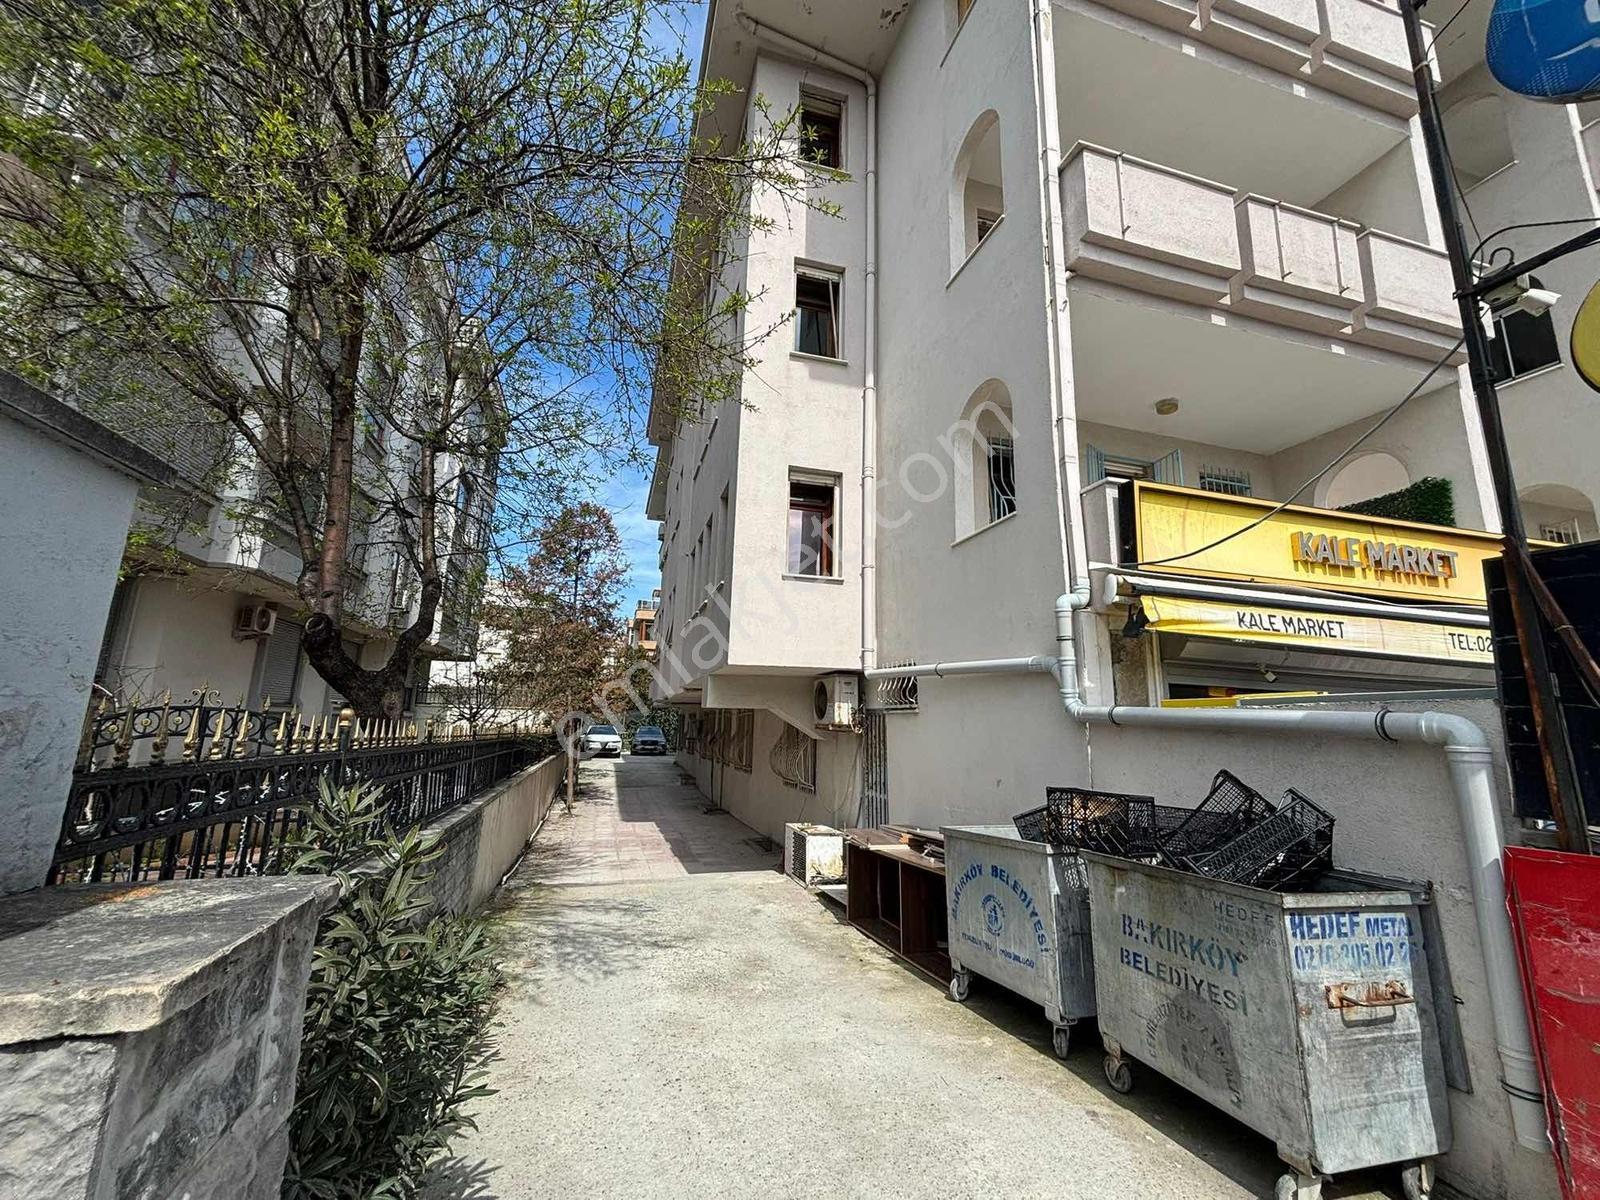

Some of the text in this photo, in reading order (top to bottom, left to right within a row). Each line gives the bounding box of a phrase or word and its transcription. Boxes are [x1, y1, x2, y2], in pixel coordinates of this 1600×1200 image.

[1292, 531, 1458, 579] KALE MARKET
[1237, 611, 1345, 639] KALE MARKET
[1289, 911, 1360, 940] HEDEF
